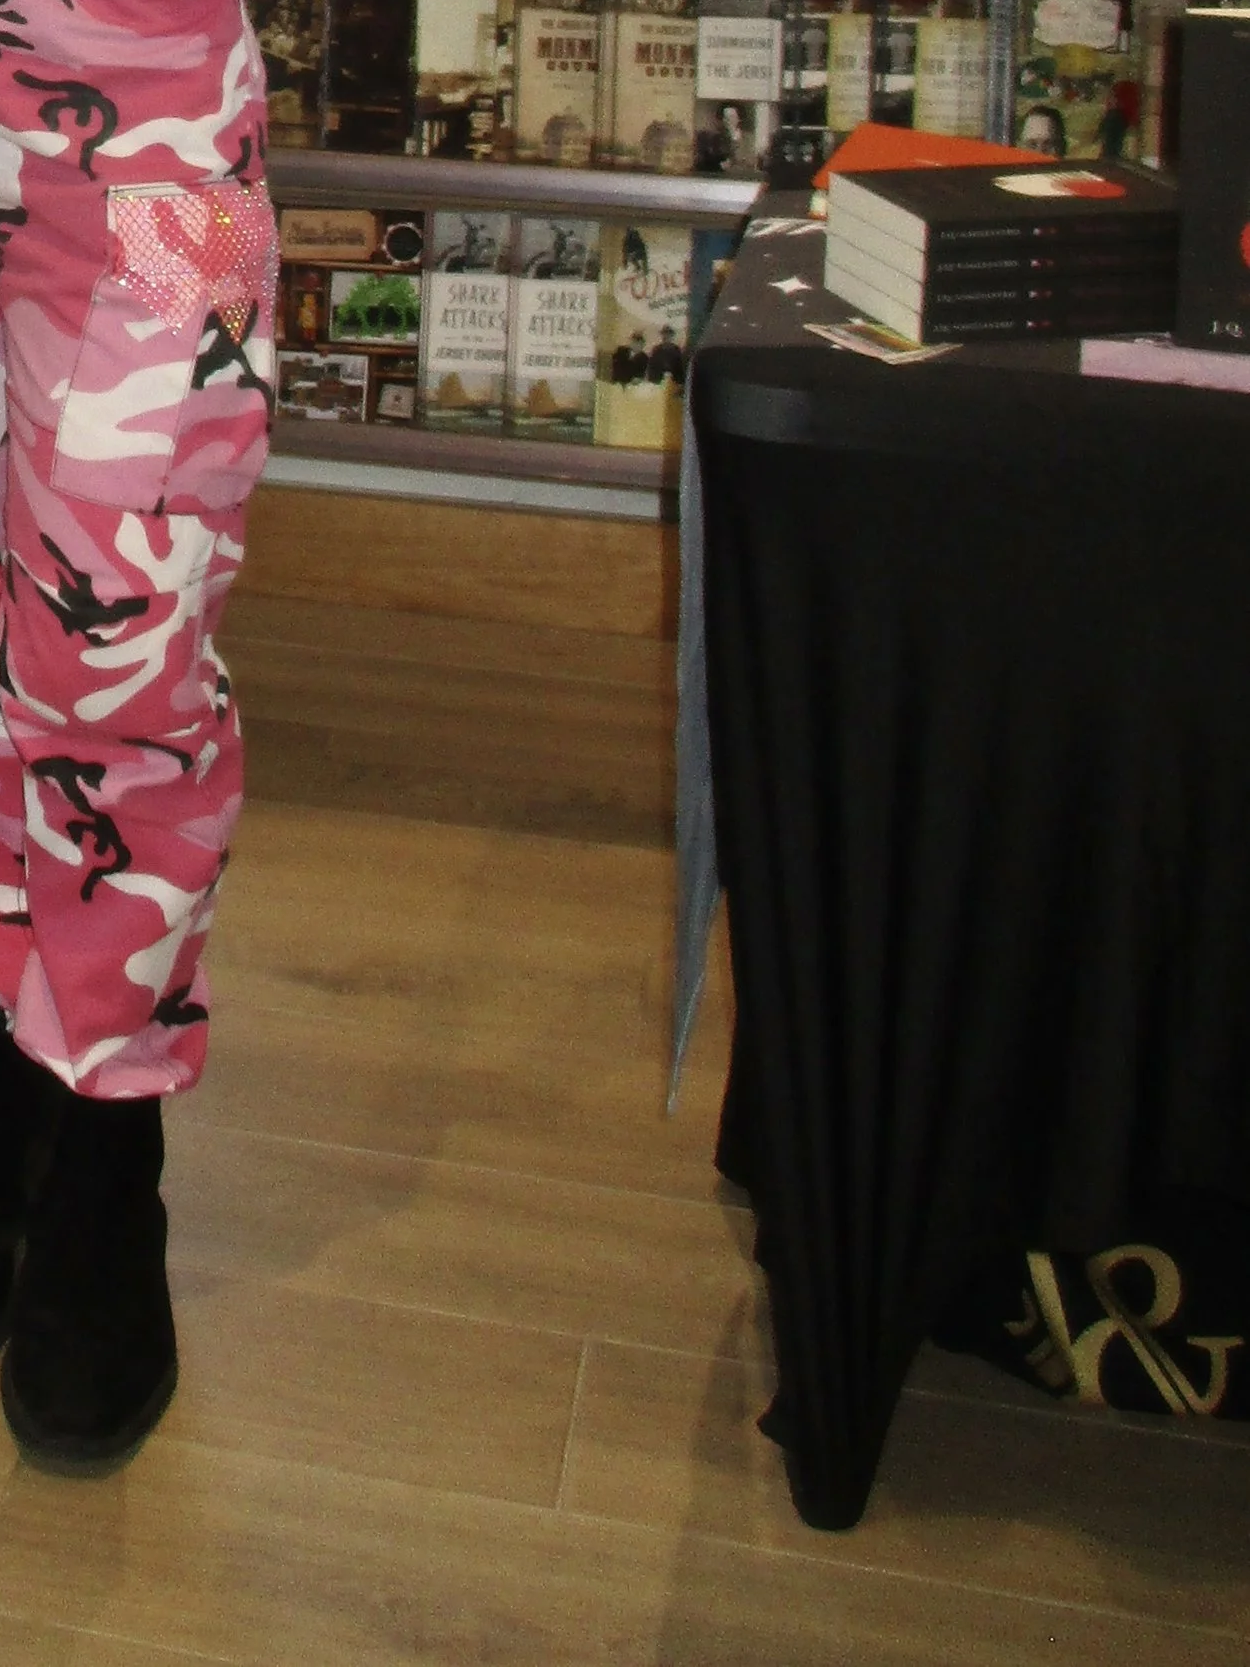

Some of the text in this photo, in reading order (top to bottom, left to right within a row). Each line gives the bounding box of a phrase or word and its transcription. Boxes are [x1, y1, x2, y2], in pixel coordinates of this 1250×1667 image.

[448, 283, 501, 305] SHARK
[536, 290, 590, 312] SHARK
[439, 308, 507, 330] ATTACKS
